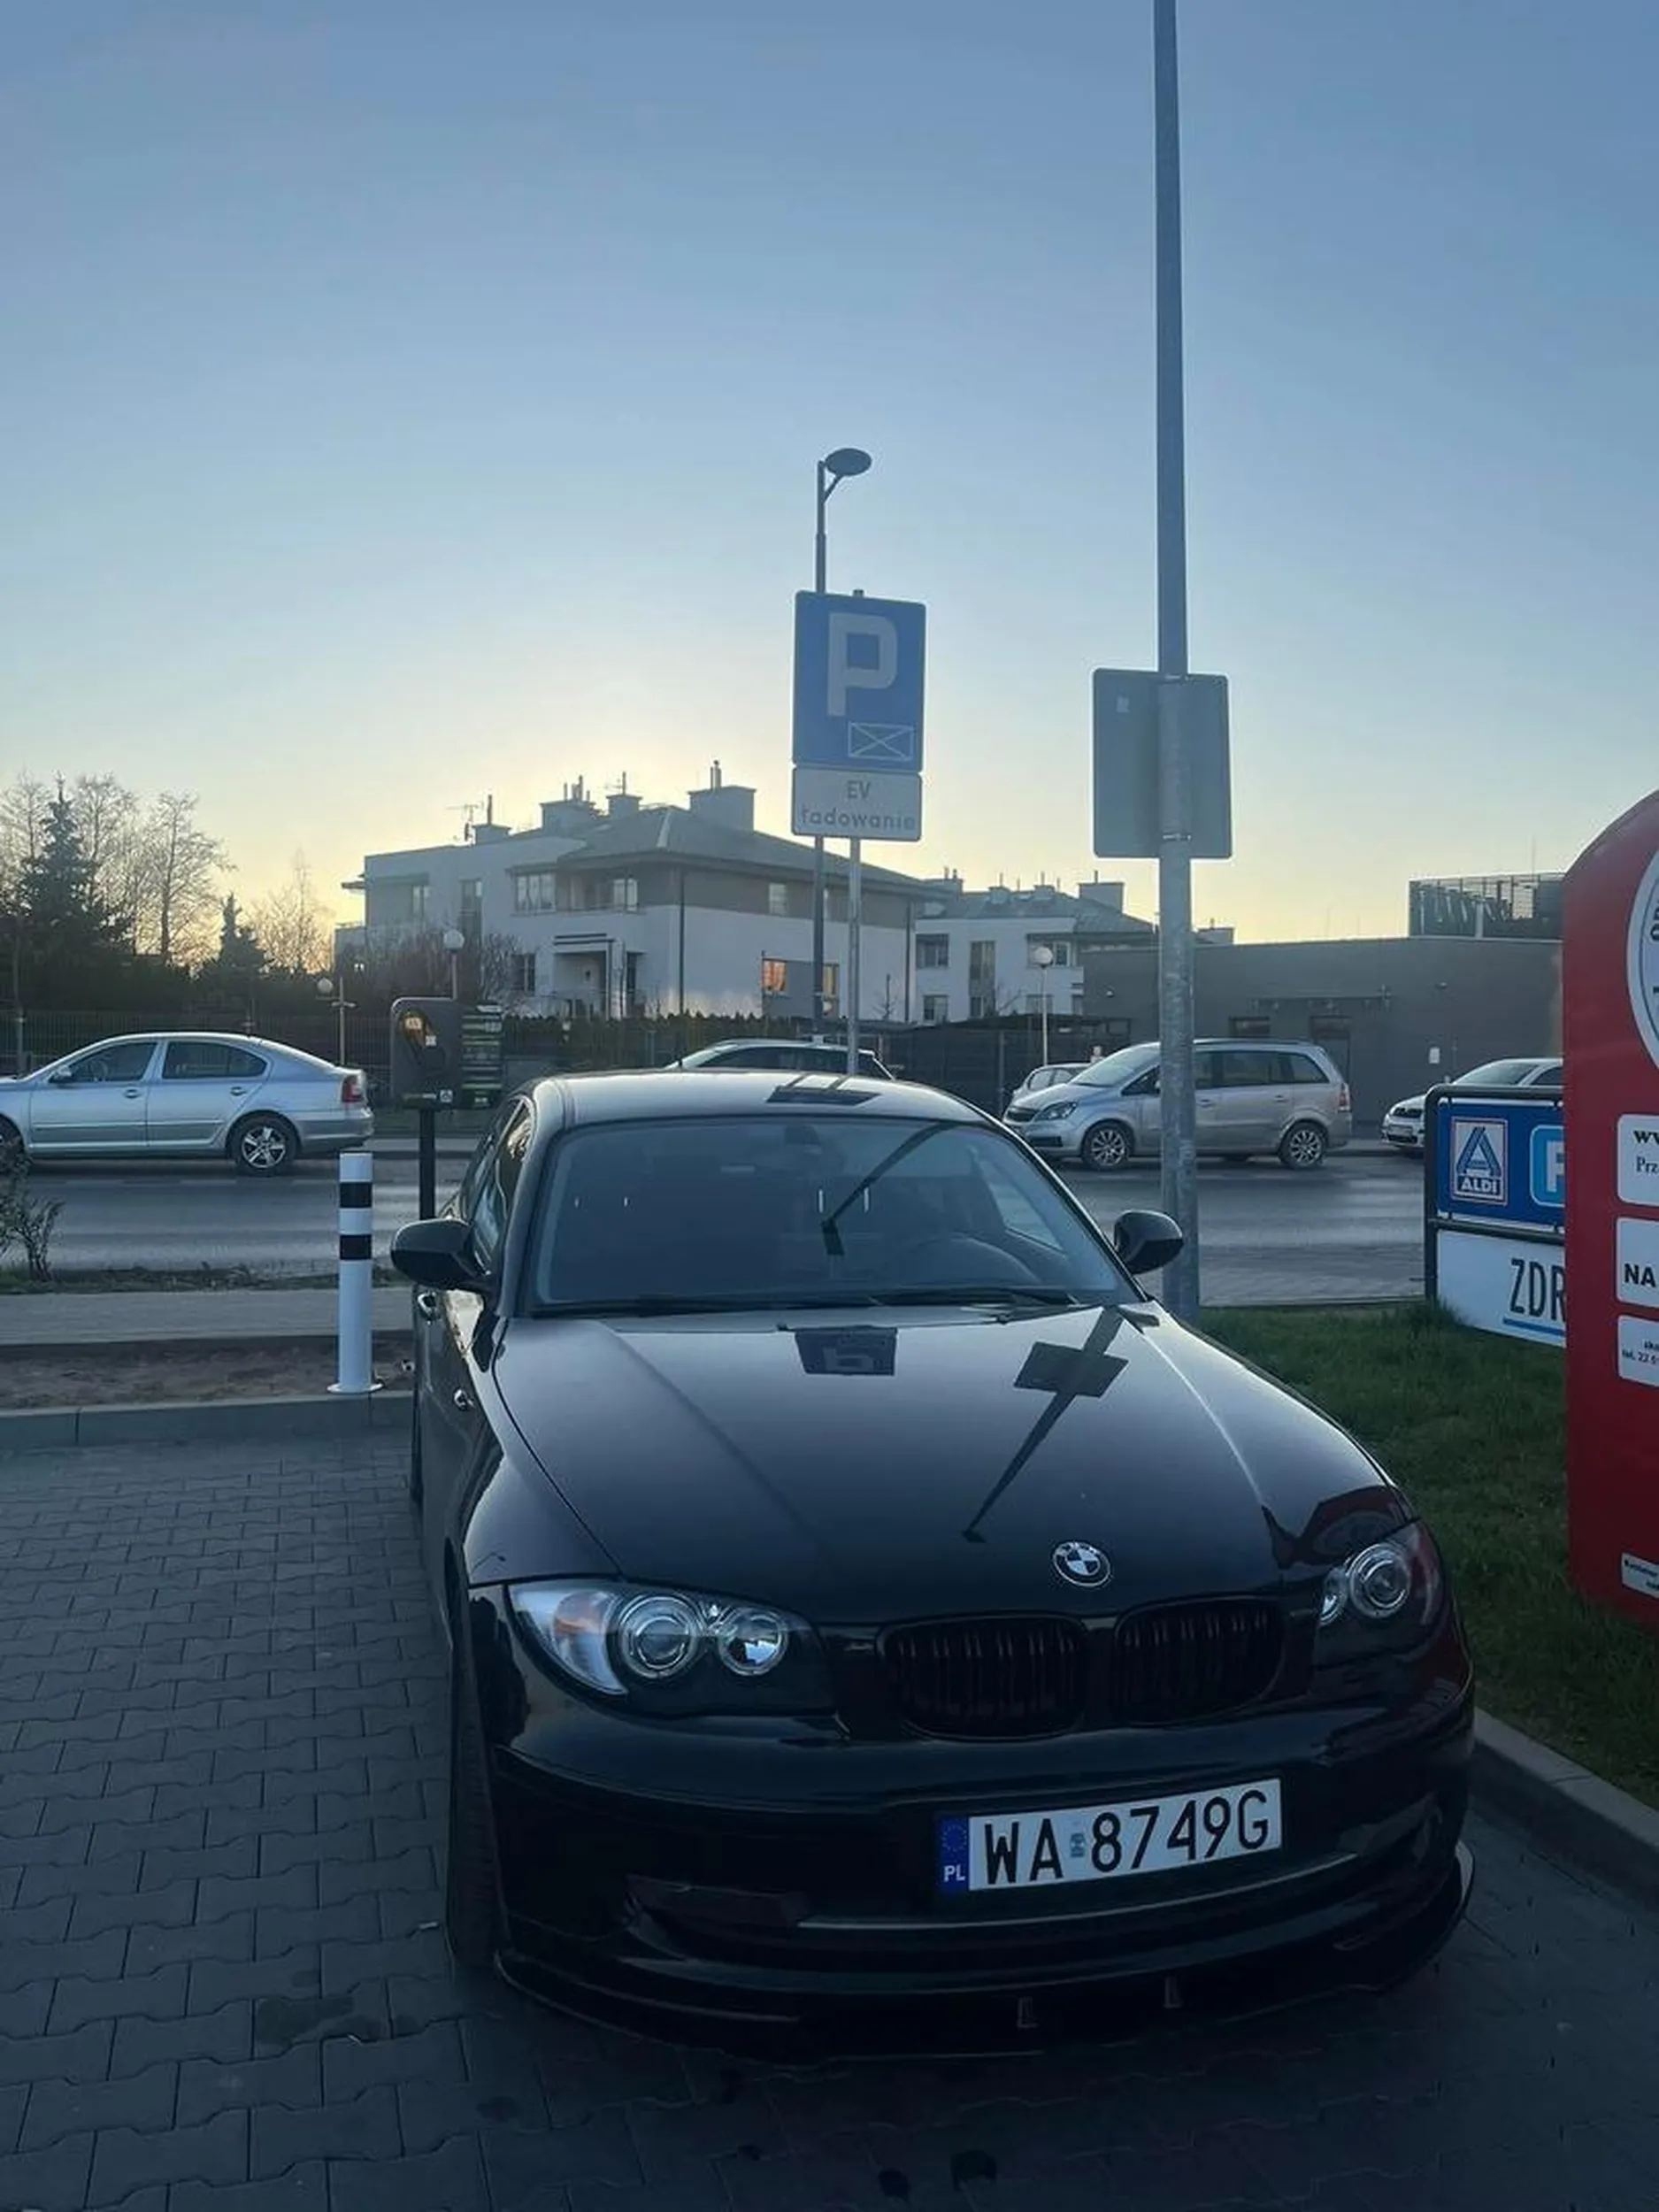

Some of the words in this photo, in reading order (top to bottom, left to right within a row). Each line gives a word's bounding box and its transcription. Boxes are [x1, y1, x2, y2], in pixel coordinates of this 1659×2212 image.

[827, 612, 898, 717] P
[847, 780, 871, 800] EV
[1461, 1177, 1497, 1194] ALDI
[1624, 1263, 1656, 1287] NA
[984, 1818, 1064, 1885] WA
[1091, 1789, 1268, 1872] 8749G
[944, 1864, 966, 1882] PL
